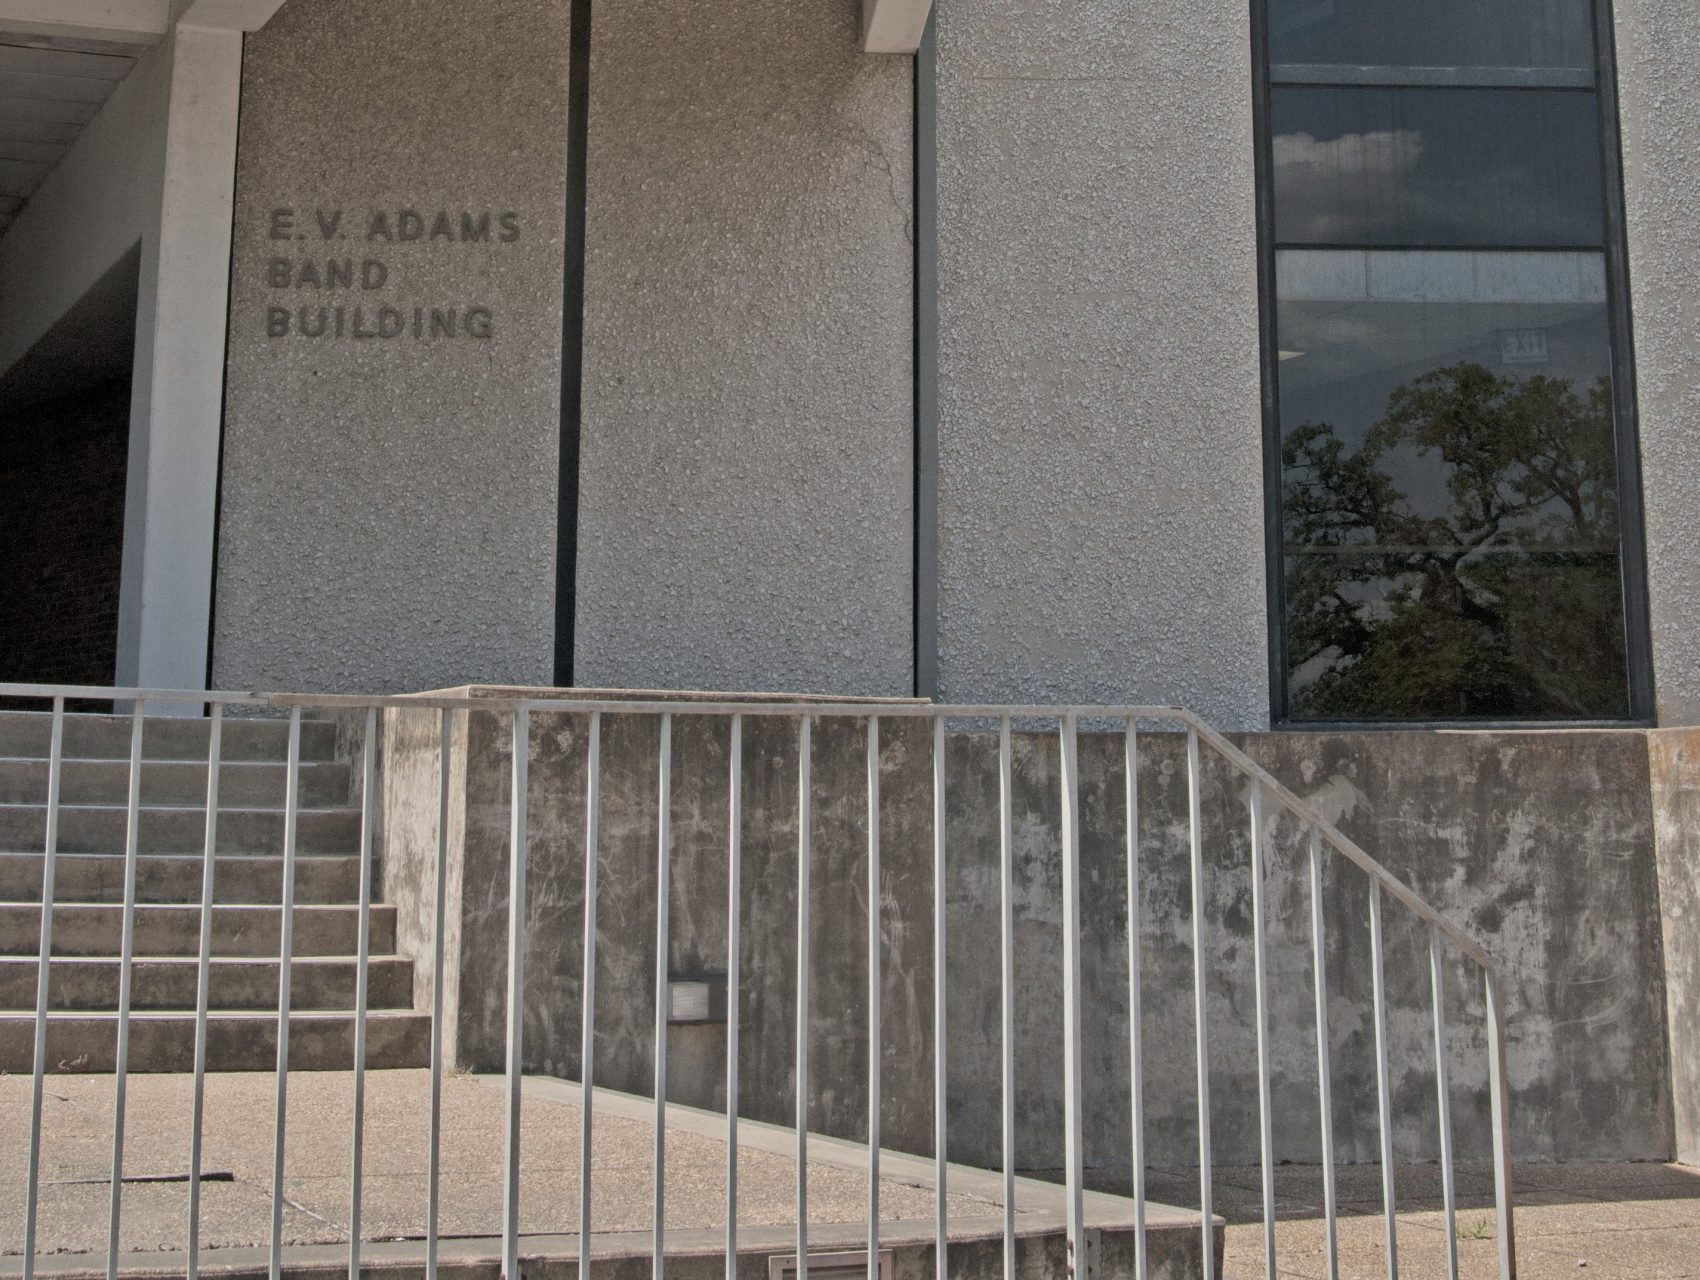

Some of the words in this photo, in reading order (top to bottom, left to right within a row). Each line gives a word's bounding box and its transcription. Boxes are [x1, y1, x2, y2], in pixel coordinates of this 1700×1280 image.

[368, 208, 520, 242] ADAMS
[268, 258, 389, 289] BAND
[267, 304, 493, 338] BUILDING
